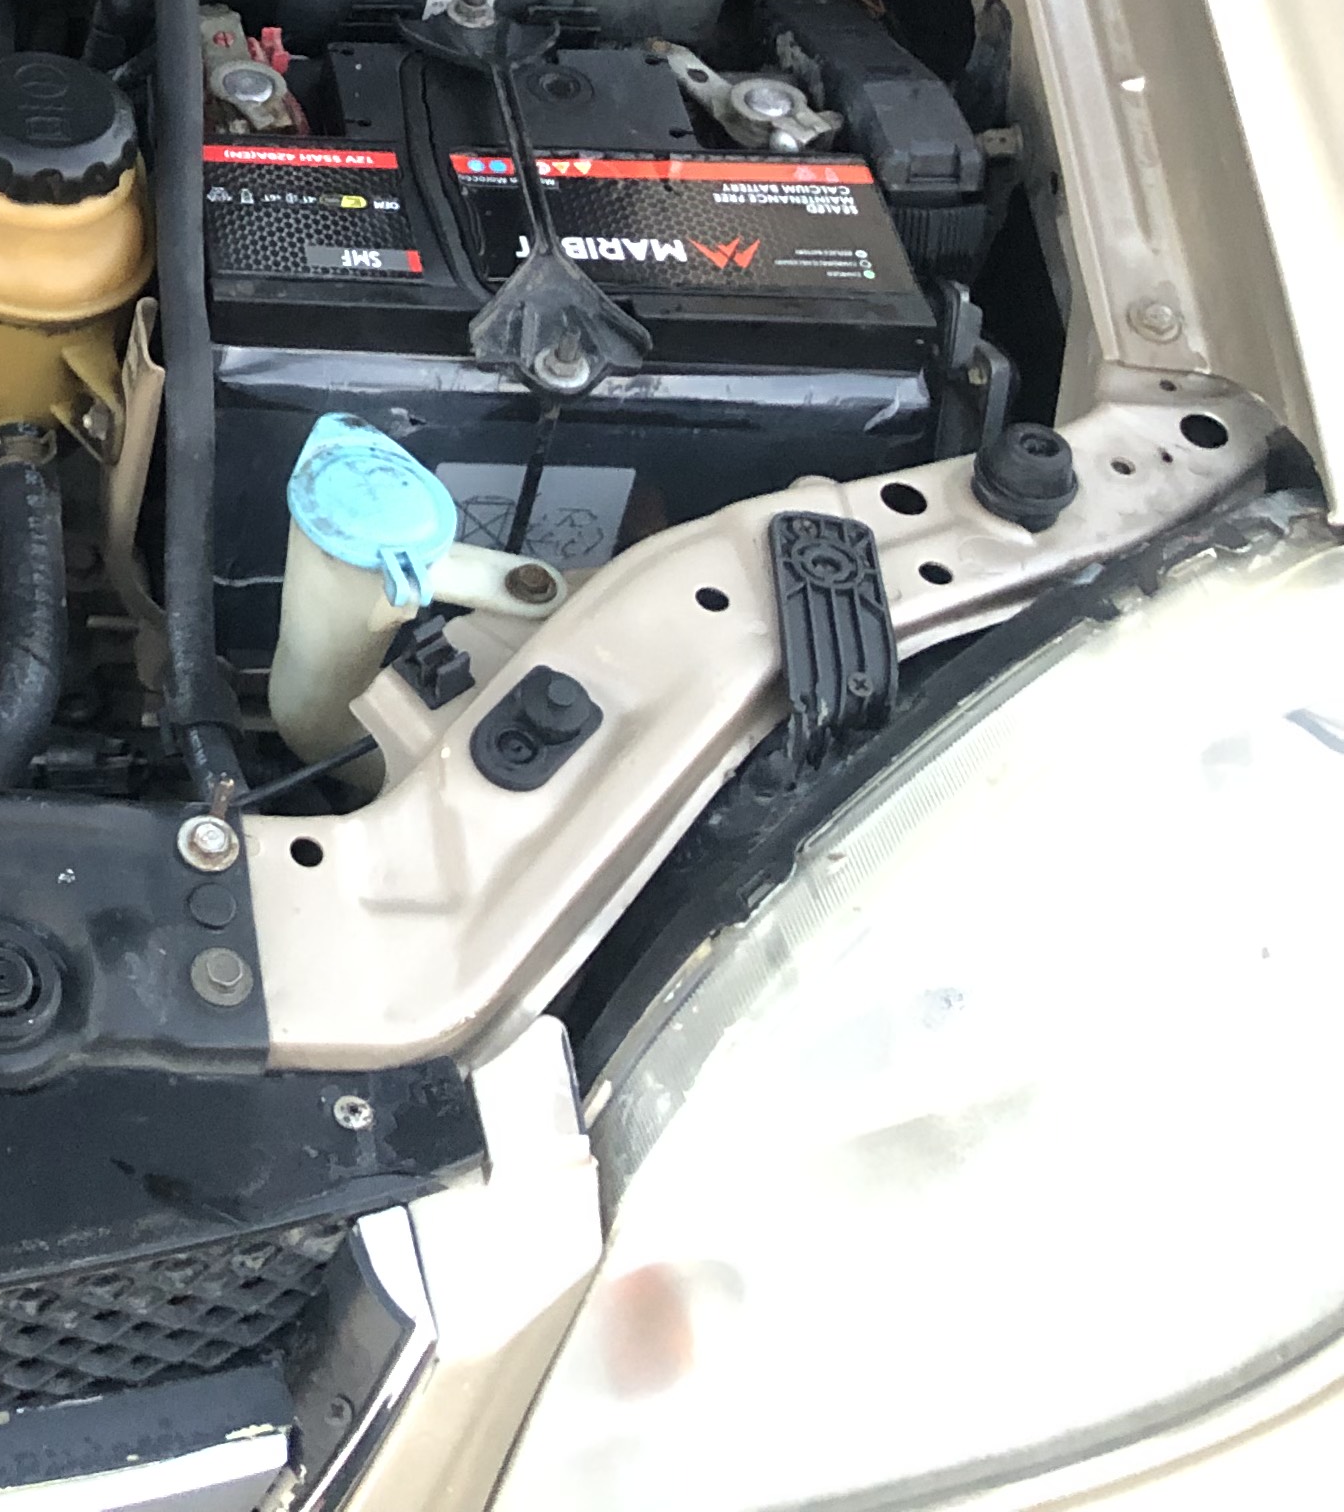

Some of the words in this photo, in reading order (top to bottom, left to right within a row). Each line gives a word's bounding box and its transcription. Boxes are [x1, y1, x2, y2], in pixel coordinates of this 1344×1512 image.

[346, 155, 374, 164] 12V
[722, 183, 779, 193] BATTERY
[782, 184, 851, 195] CALCIUM
[712, 192, 745, 203] FREE
[749, 193, 854, 205] MAINTENANCE
[806, 203, 859, 215] SEALED
[515, 234, 688, 262] MARIBT
[340, 249, 383, 268] SMF
